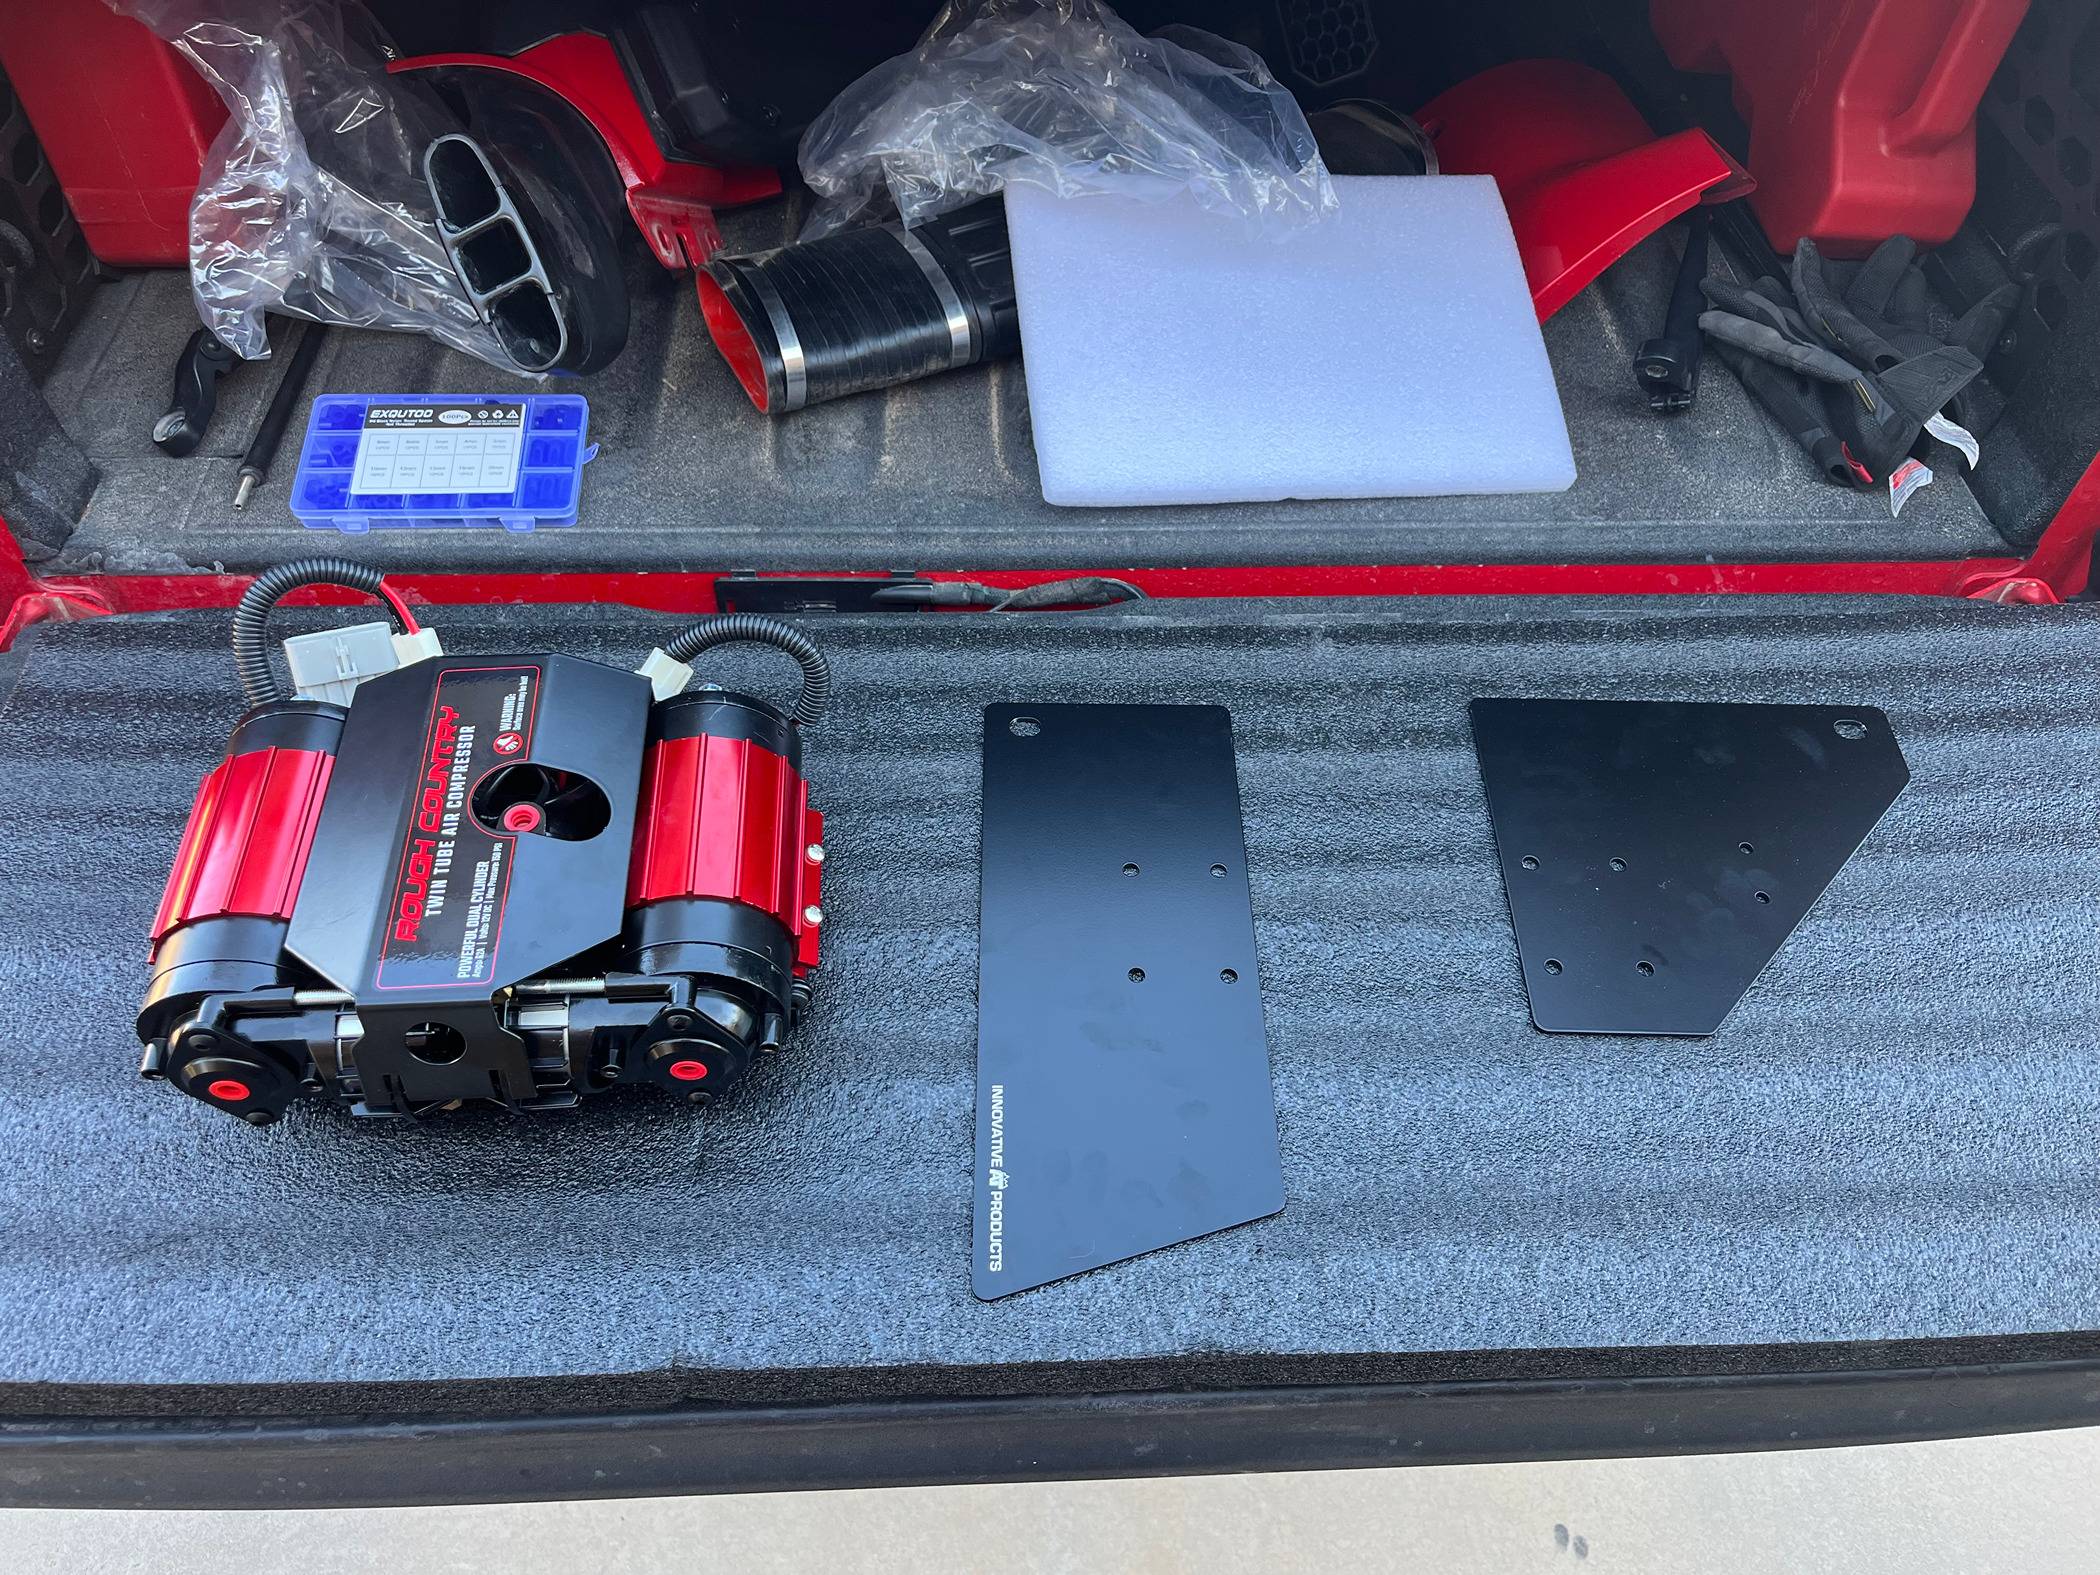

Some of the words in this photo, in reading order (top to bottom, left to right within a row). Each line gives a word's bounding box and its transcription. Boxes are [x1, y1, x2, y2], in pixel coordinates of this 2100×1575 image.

[499, 694, 517, 731] WARNING:
[446, 725, 476, 808] COMPRESSOR
[395, 838, 436, 941] ROUGH
[416, 705, 459, 833] COUNTRY
[442, 813, 461, 835] AIR
[432, 841, 456, 874] TUBE
[490, 852, 502, 861] 150
[493, 843, 503, 851] PSI
[425, 880, 448, 917] TWIN
[470, 861, 489, 902] CYLINDER
[466, 904, 482, 927] DUAL
[481, 914, 491, 922] 12V
[483, 905, 492, 913] DC
[457, 928, 477, 978] POWERFUL
[991, 1085, 1003, 1167] INNOVATIVE
[989, 1191, 1003, 1272] PRODUCTS
